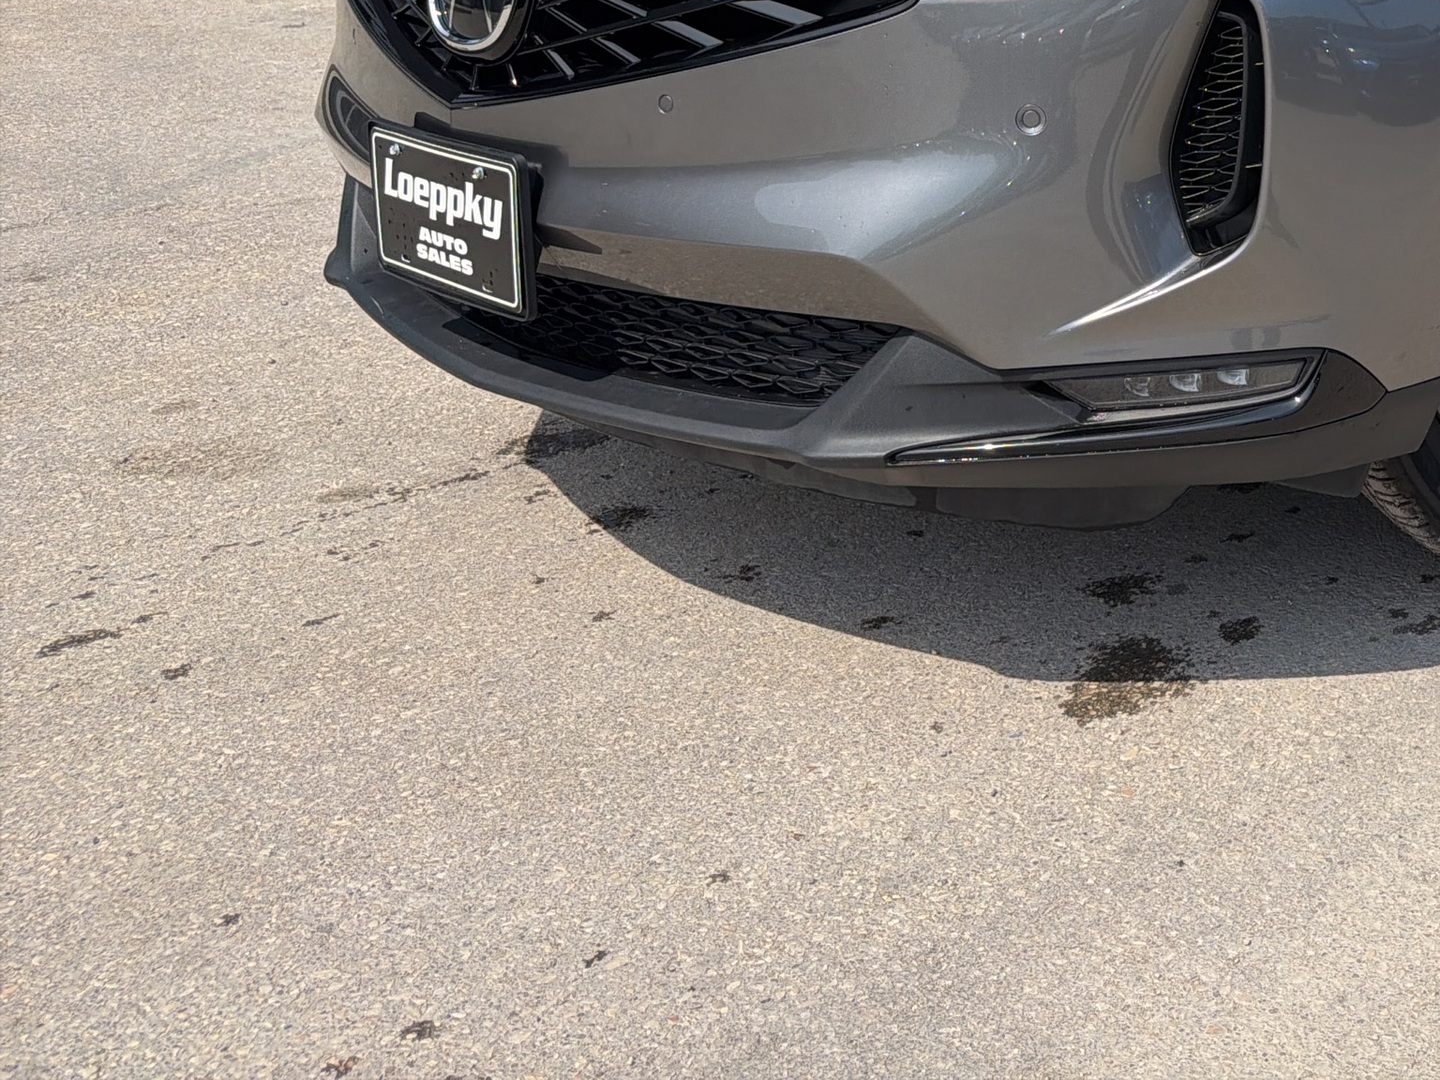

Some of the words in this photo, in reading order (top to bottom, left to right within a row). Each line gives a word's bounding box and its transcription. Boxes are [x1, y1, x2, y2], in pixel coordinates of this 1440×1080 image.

[384, 157, 503, 240] Loeppky
[419, 226, 468, 256] AUTO
[416, 243, 474, 276] SALES
